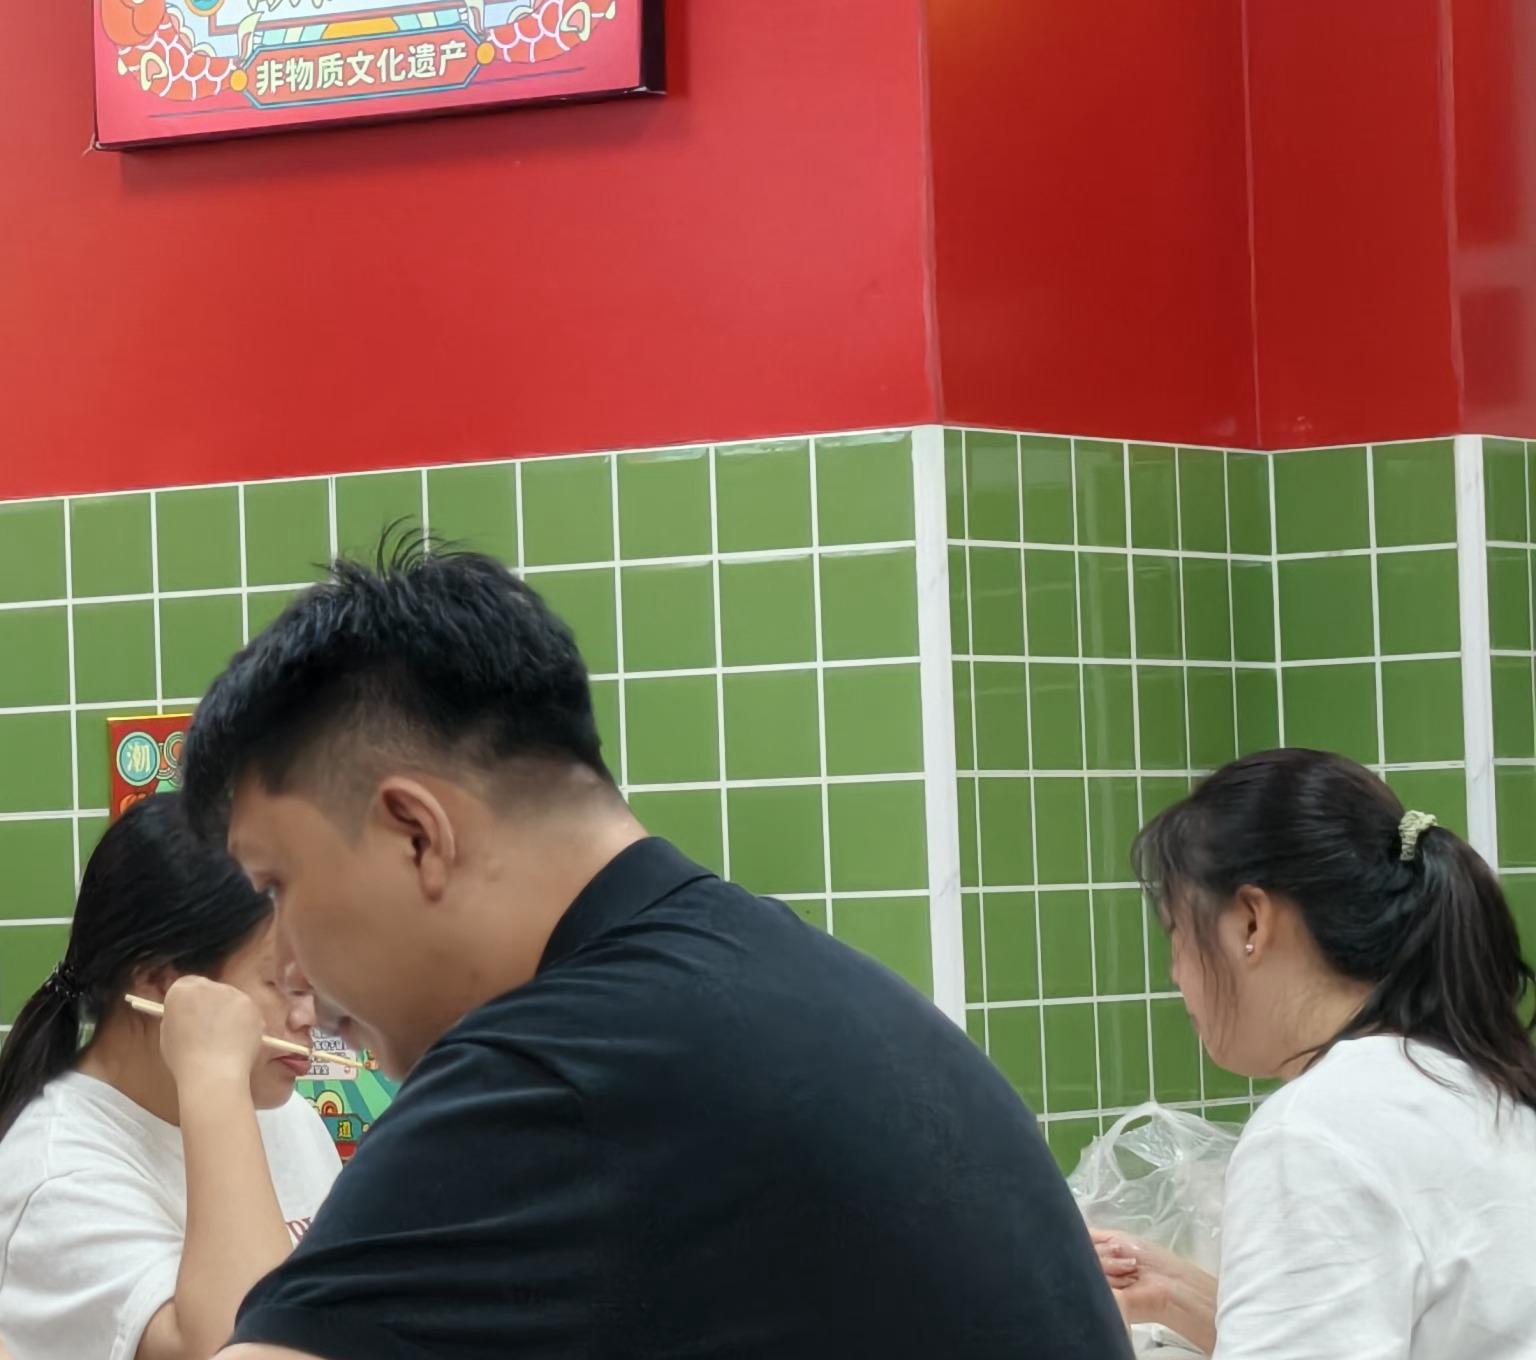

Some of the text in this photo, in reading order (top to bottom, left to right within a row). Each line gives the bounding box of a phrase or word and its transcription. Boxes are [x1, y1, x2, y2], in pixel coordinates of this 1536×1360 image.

[255, 39, 468, 96] 非物质文化遗产
